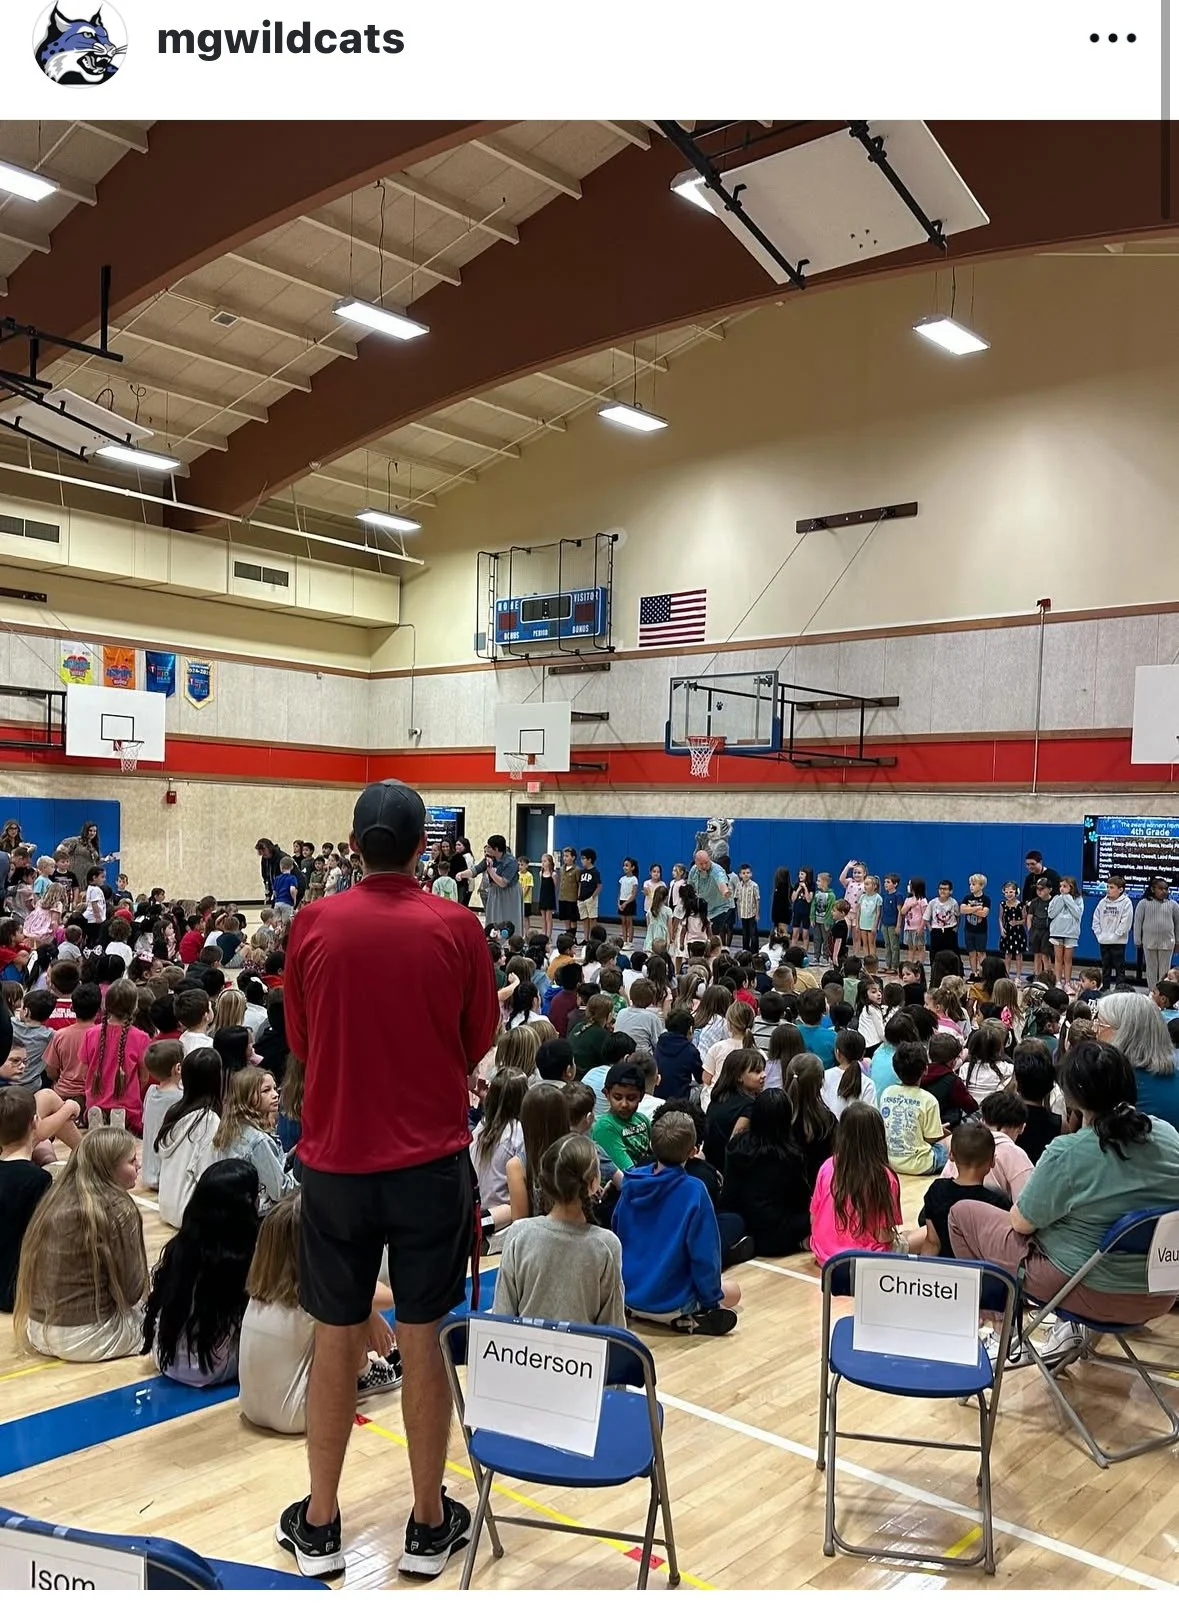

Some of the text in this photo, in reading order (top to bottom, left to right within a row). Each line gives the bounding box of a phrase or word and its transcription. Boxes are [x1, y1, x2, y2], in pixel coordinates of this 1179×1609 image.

[1145, 828, 1170, 836] Grade
[879, 1275, 958, 1300] Christel
[482, 1341, 593, 1379] Anderson
[31, 1560, 95, 1590] Isom
